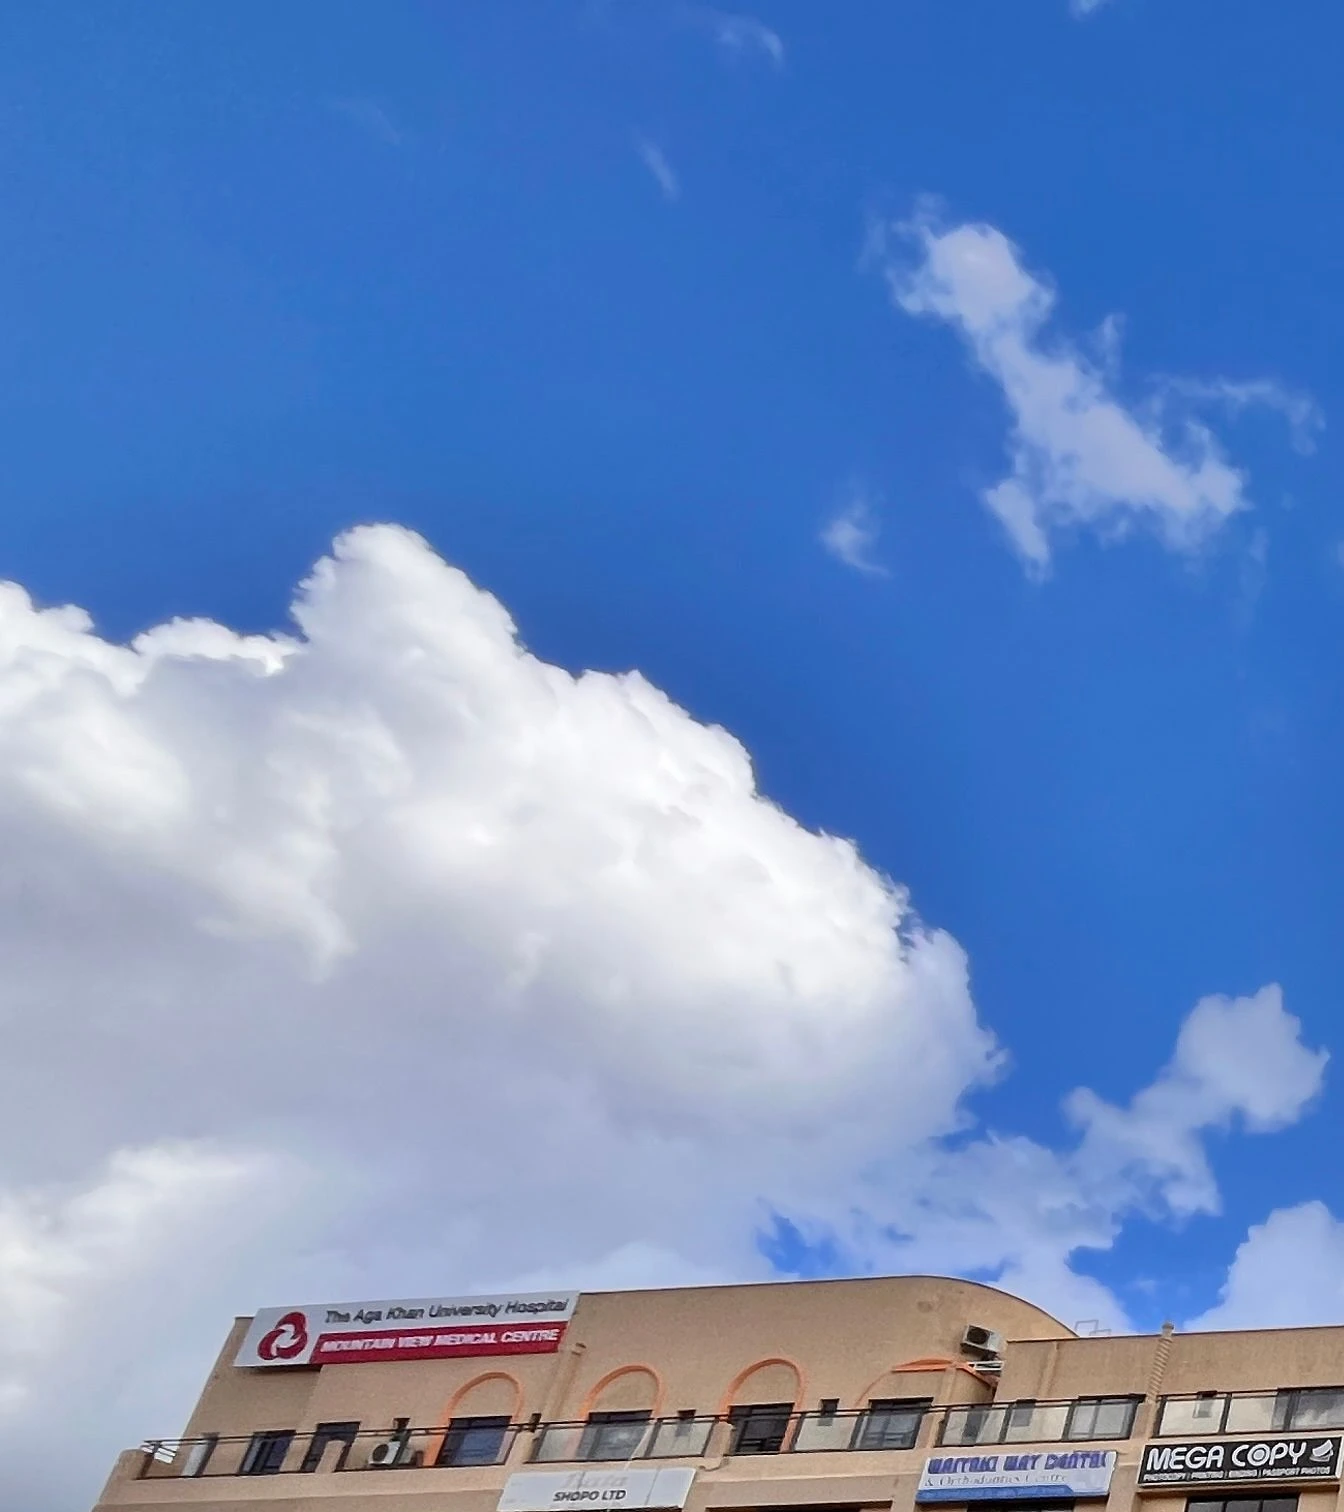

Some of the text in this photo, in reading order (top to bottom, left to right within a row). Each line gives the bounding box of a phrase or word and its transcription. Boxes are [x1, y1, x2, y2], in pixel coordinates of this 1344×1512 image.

[326, 1299, 569, 1324] The Aga Khan University Hospital
[320, 1329, 561, 1352] MOUNTAIN VIEW MEDICAL CENTRE
[1146, 1442, 1307, 1471] MEGA COPY
[1262, 1467, 1301, 1477] PASSPORT
[1300, 1466, 1330, 1475] PHOTOS
[553, 1489, 627, 1502] SHOPO LTD
